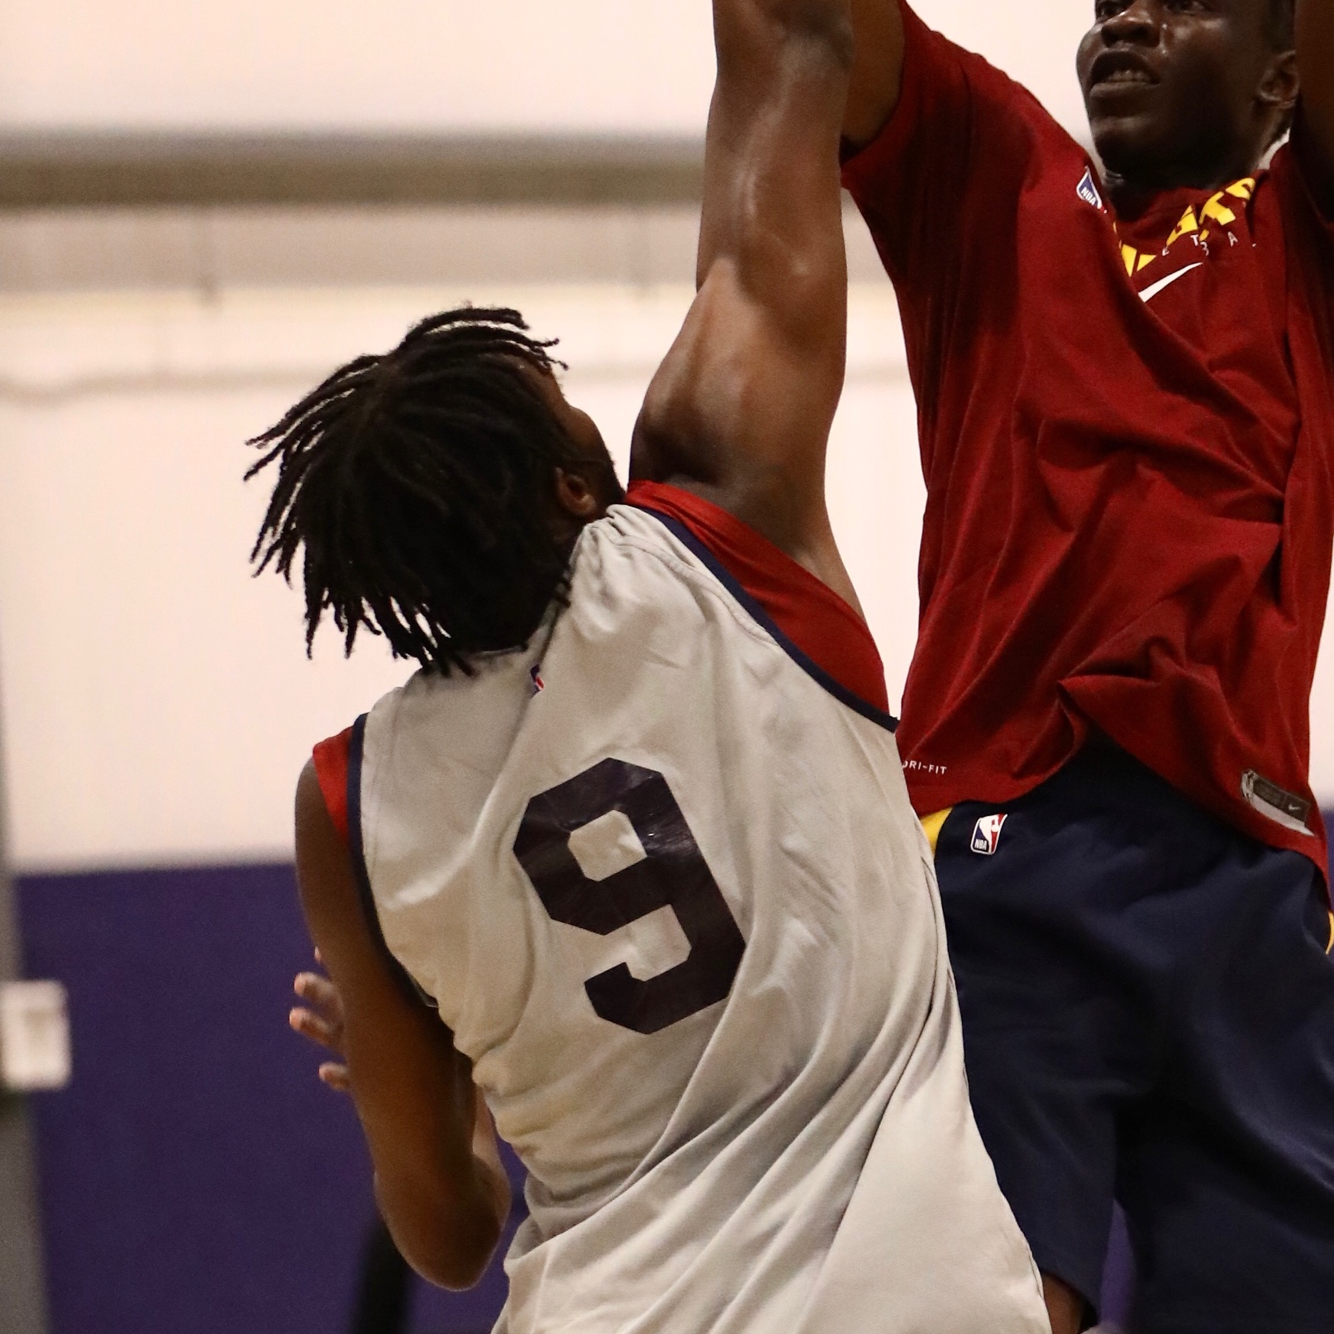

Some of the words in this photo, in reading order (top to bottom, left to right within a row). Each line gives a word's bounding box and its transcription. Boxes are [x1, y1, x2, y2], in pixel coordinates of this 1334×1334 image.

[1080, 186, 1098, 206] NBA
[974, 838, 988, 851] NBA
[512, 756, 747, 1035] 9
